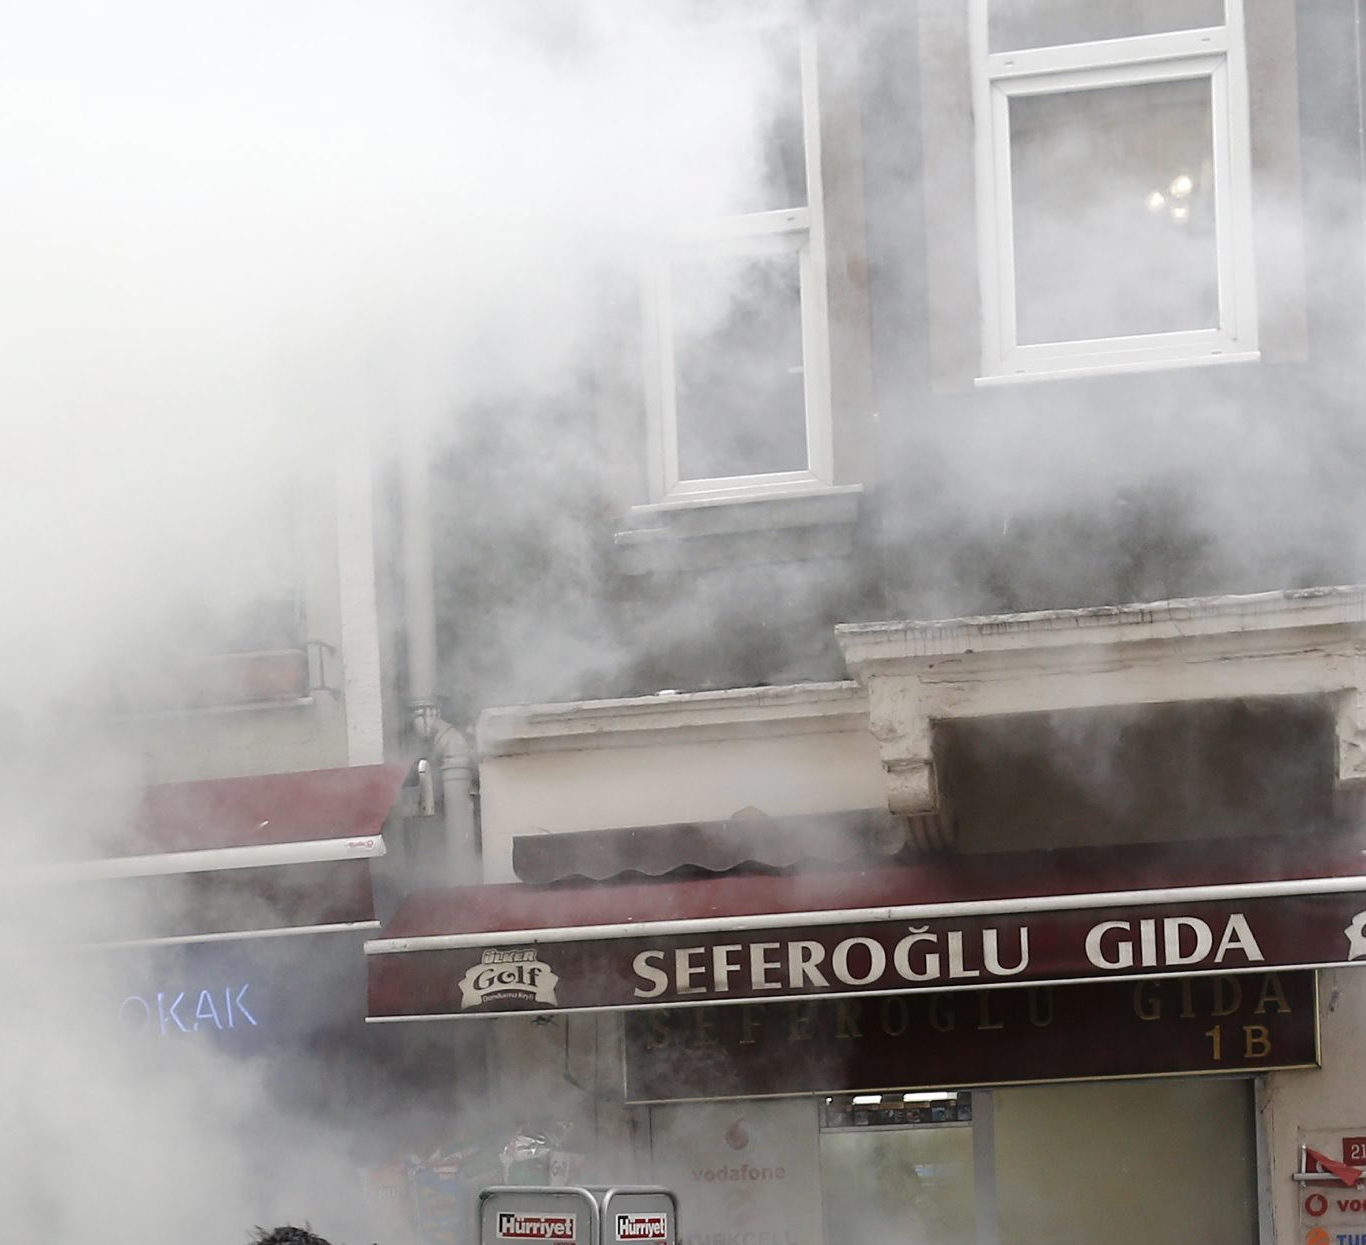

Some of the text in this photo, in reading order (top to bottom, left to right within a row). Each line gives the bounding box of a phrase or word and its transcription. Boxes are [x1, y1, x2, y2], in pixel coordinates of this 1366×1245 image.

[482, 949, 536, 964] ÜLKER
[632, 913, 1265, 998] SEFEROĞLU GIDA
[473, 965, 542, 990] Golf
[1134, 974, 1292, 1021] GIDA
[1205, 1025, 1272, 1060] 1 B
[691, 1164, 785, 1182] vodafone
[501, 1216, 572, 1238] Hürriyet
[619, 1217, 665, 1238] Hürriyet
